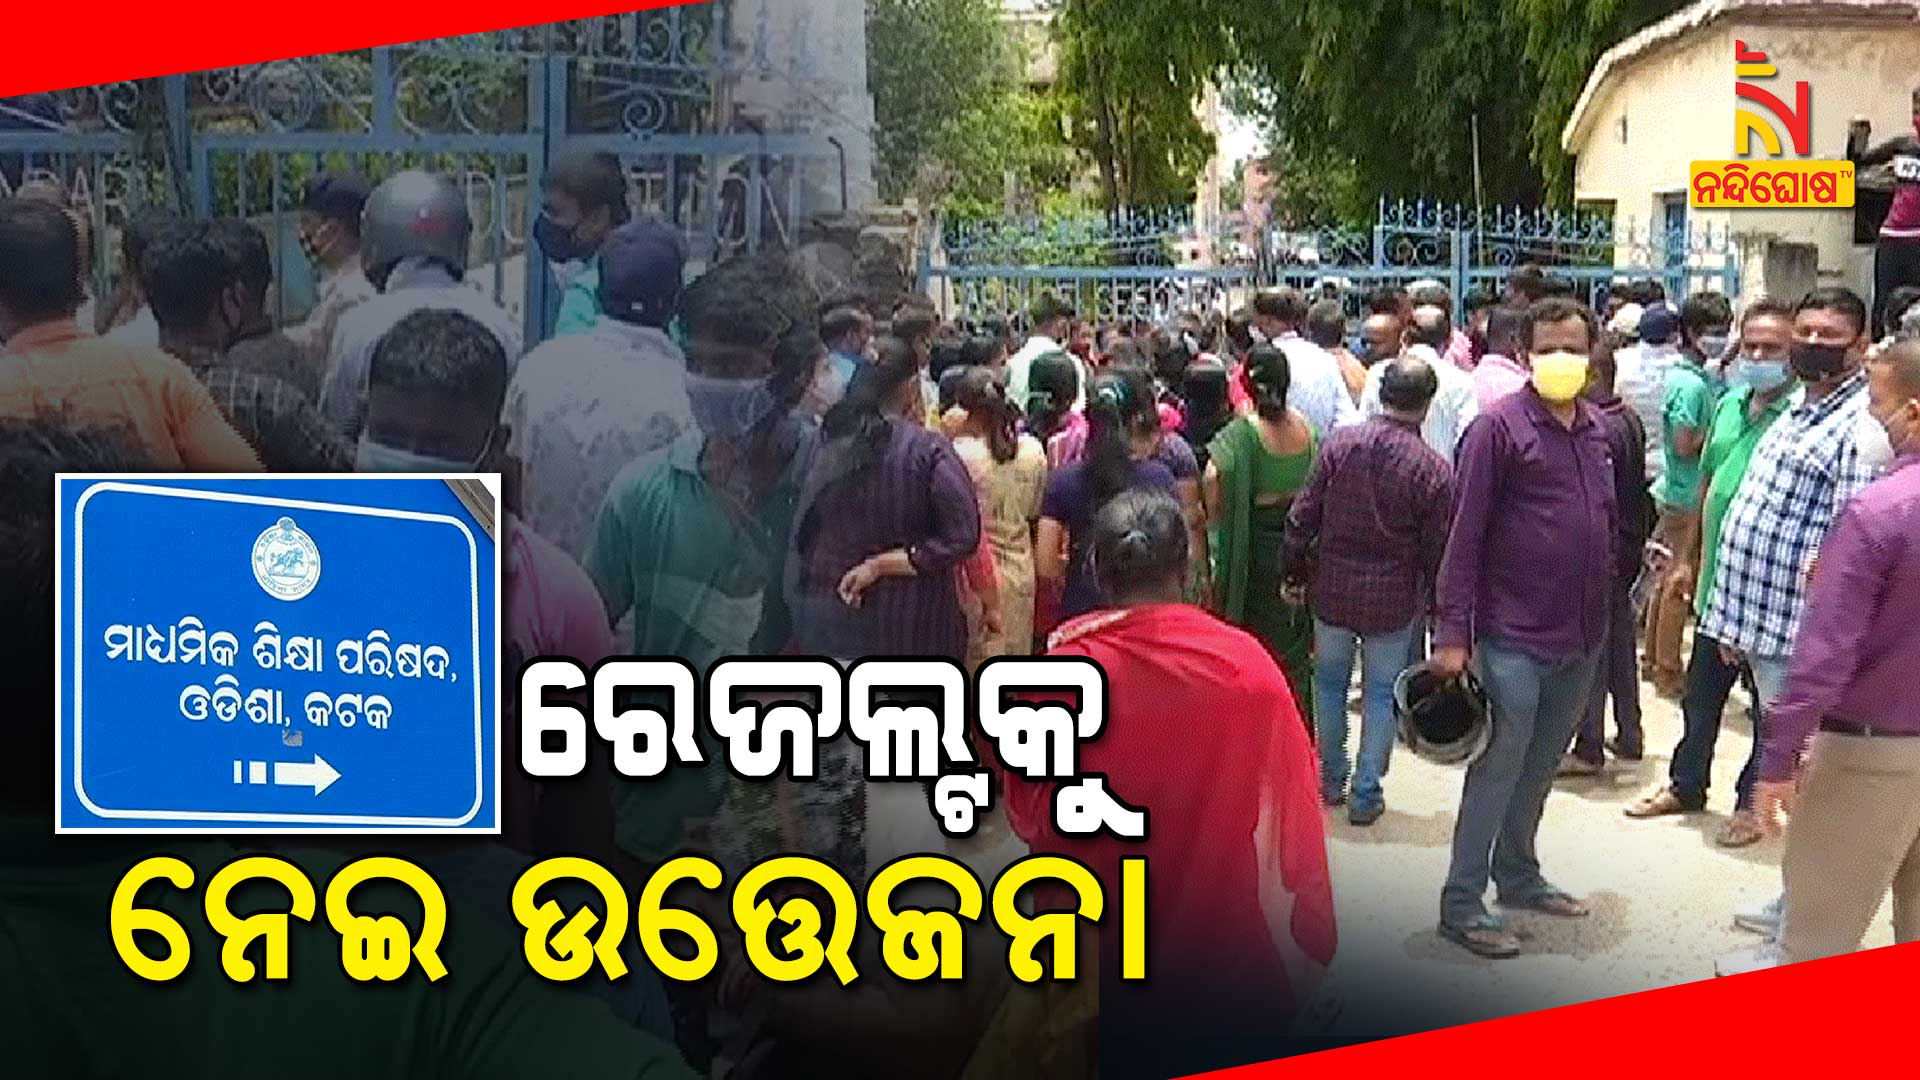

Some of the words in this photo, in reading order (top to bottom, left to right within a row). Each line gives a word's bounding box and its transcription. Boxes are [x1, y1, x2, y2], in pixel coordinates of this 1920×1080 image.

[104, 616, 239, 666] ମାଧ୍ୟମିକ
[252, 621, 324, 672] ଶିକ୍ଷା
[335, 629, 458, 683] ପରିଷଦ,
[304, 691, 393, 730] କଟକ
